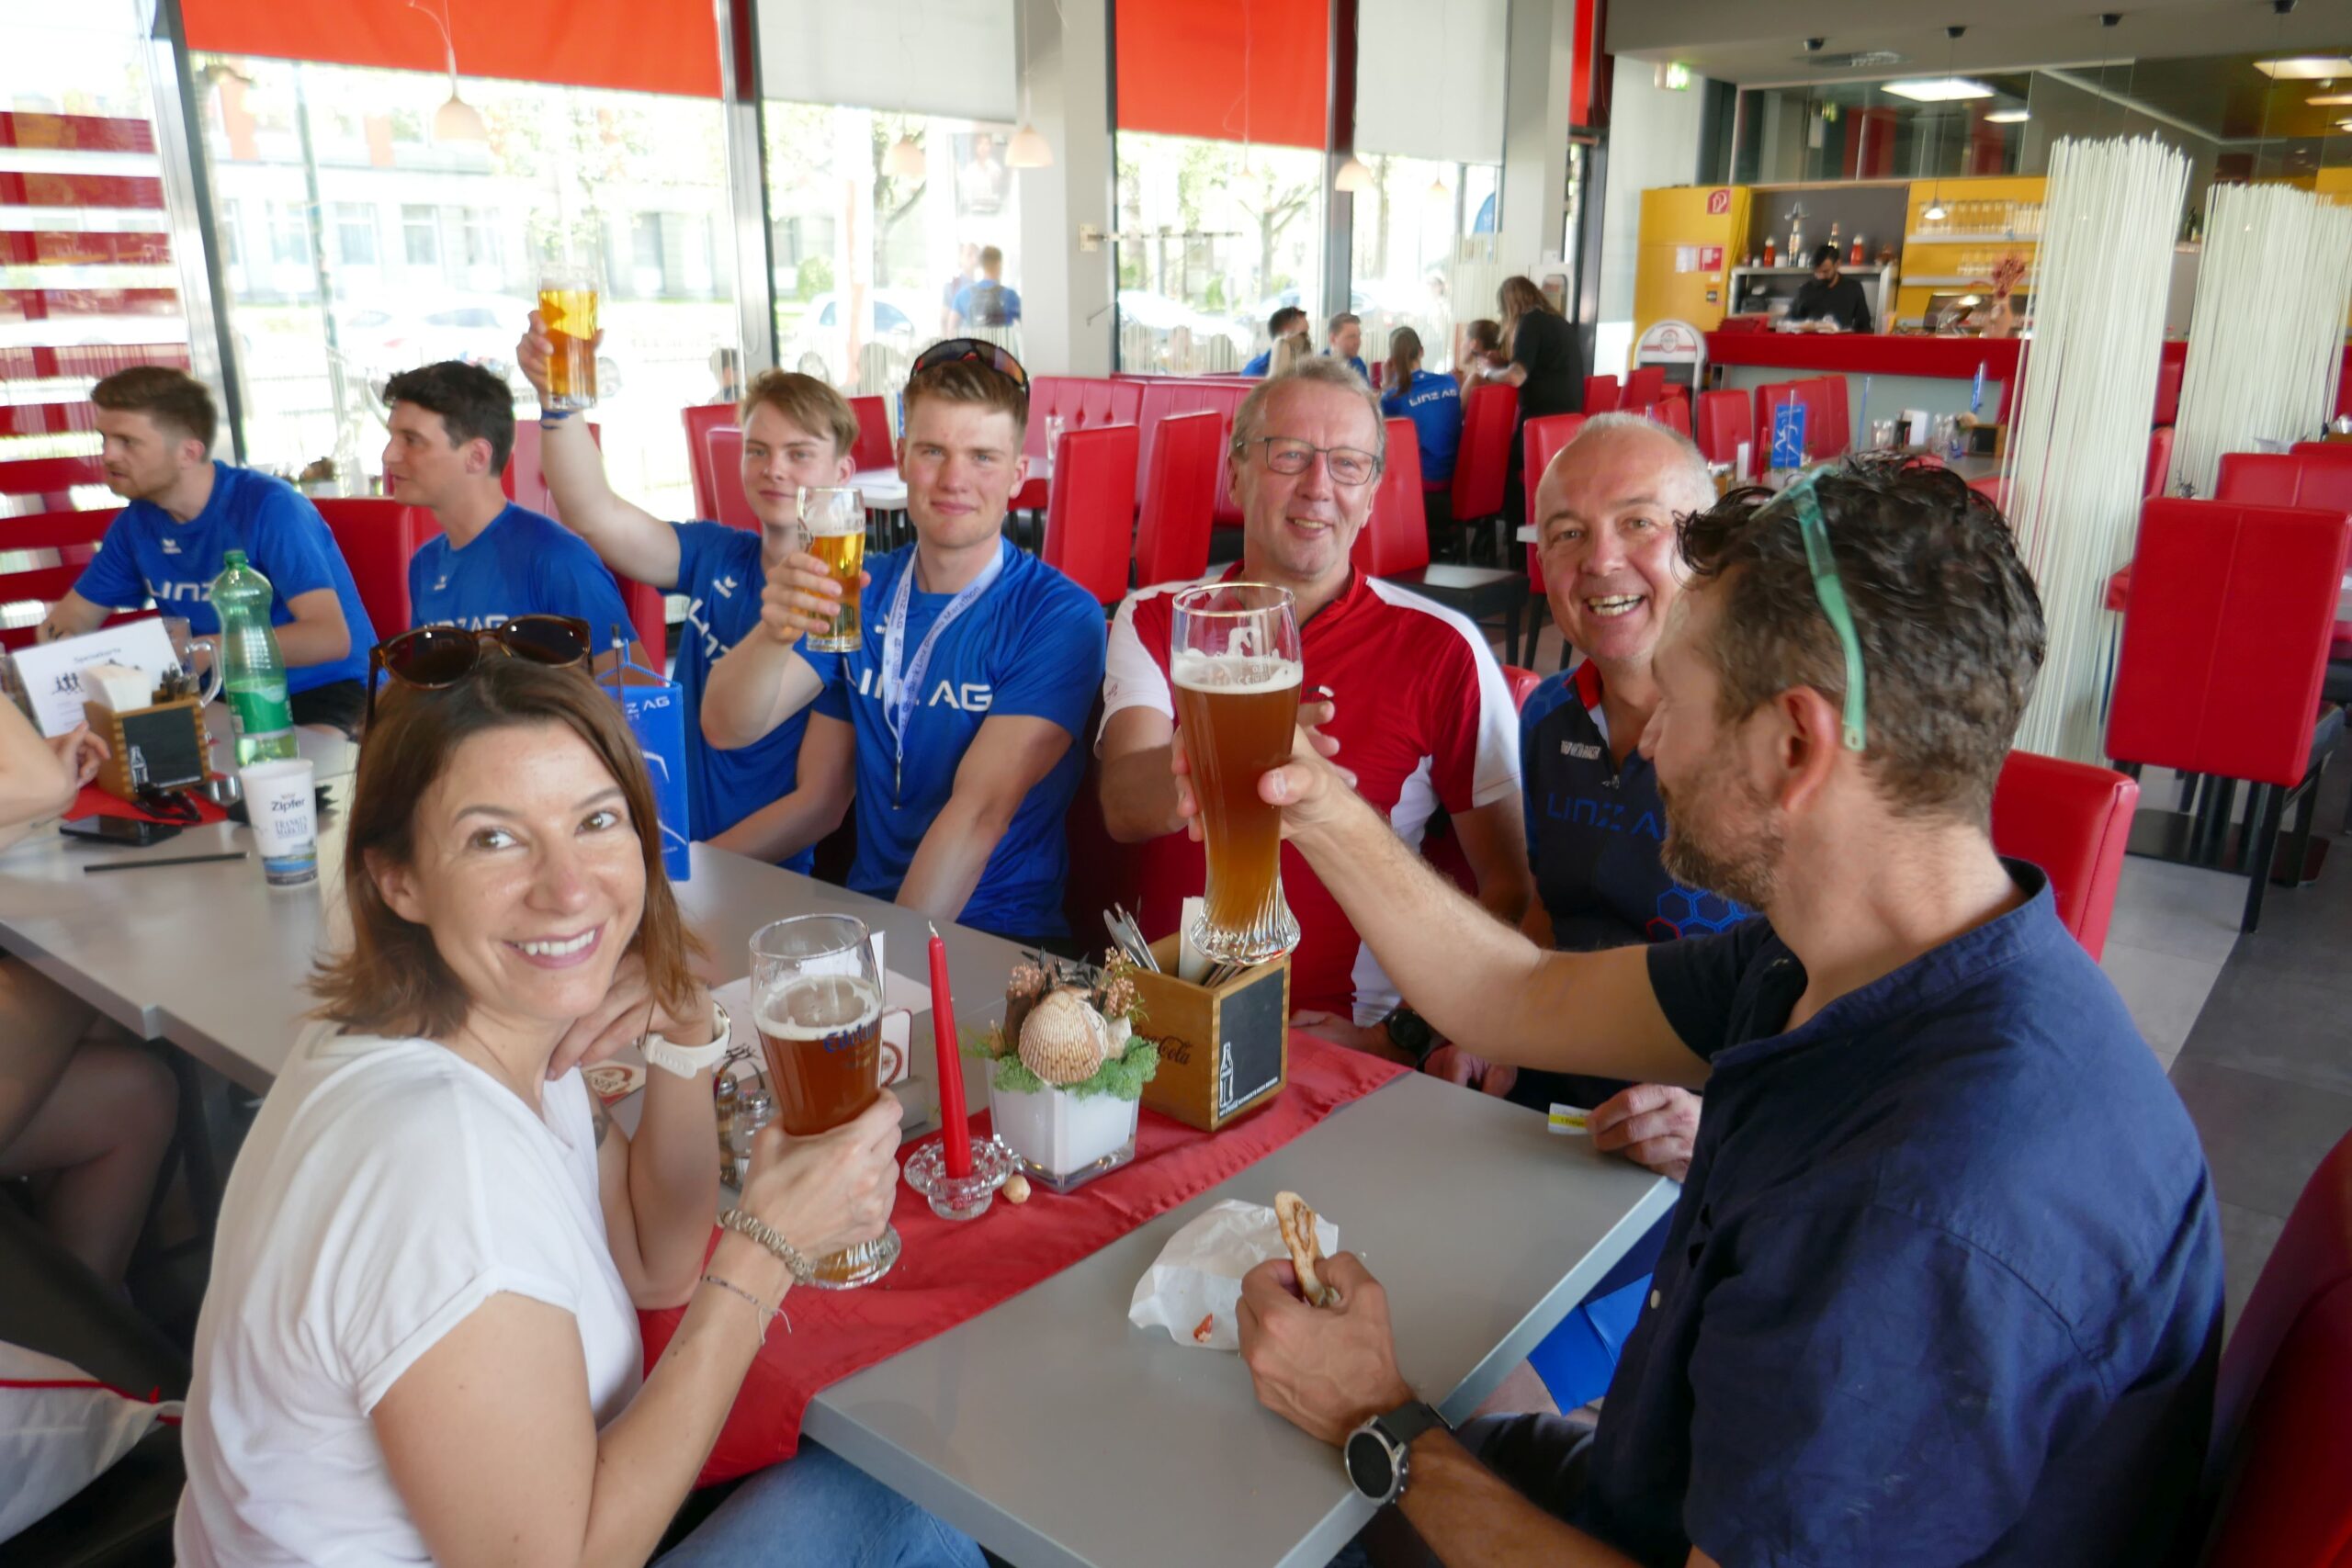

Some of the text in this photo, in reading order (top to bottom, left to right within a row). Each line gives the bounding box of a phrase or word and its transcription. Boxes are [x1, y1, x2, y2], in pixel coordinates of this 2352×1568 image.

[943, 585, 982, 622] Marathon
[928, 680, 994, 712] AG
[271, 798, 305, 813] Zipfer
